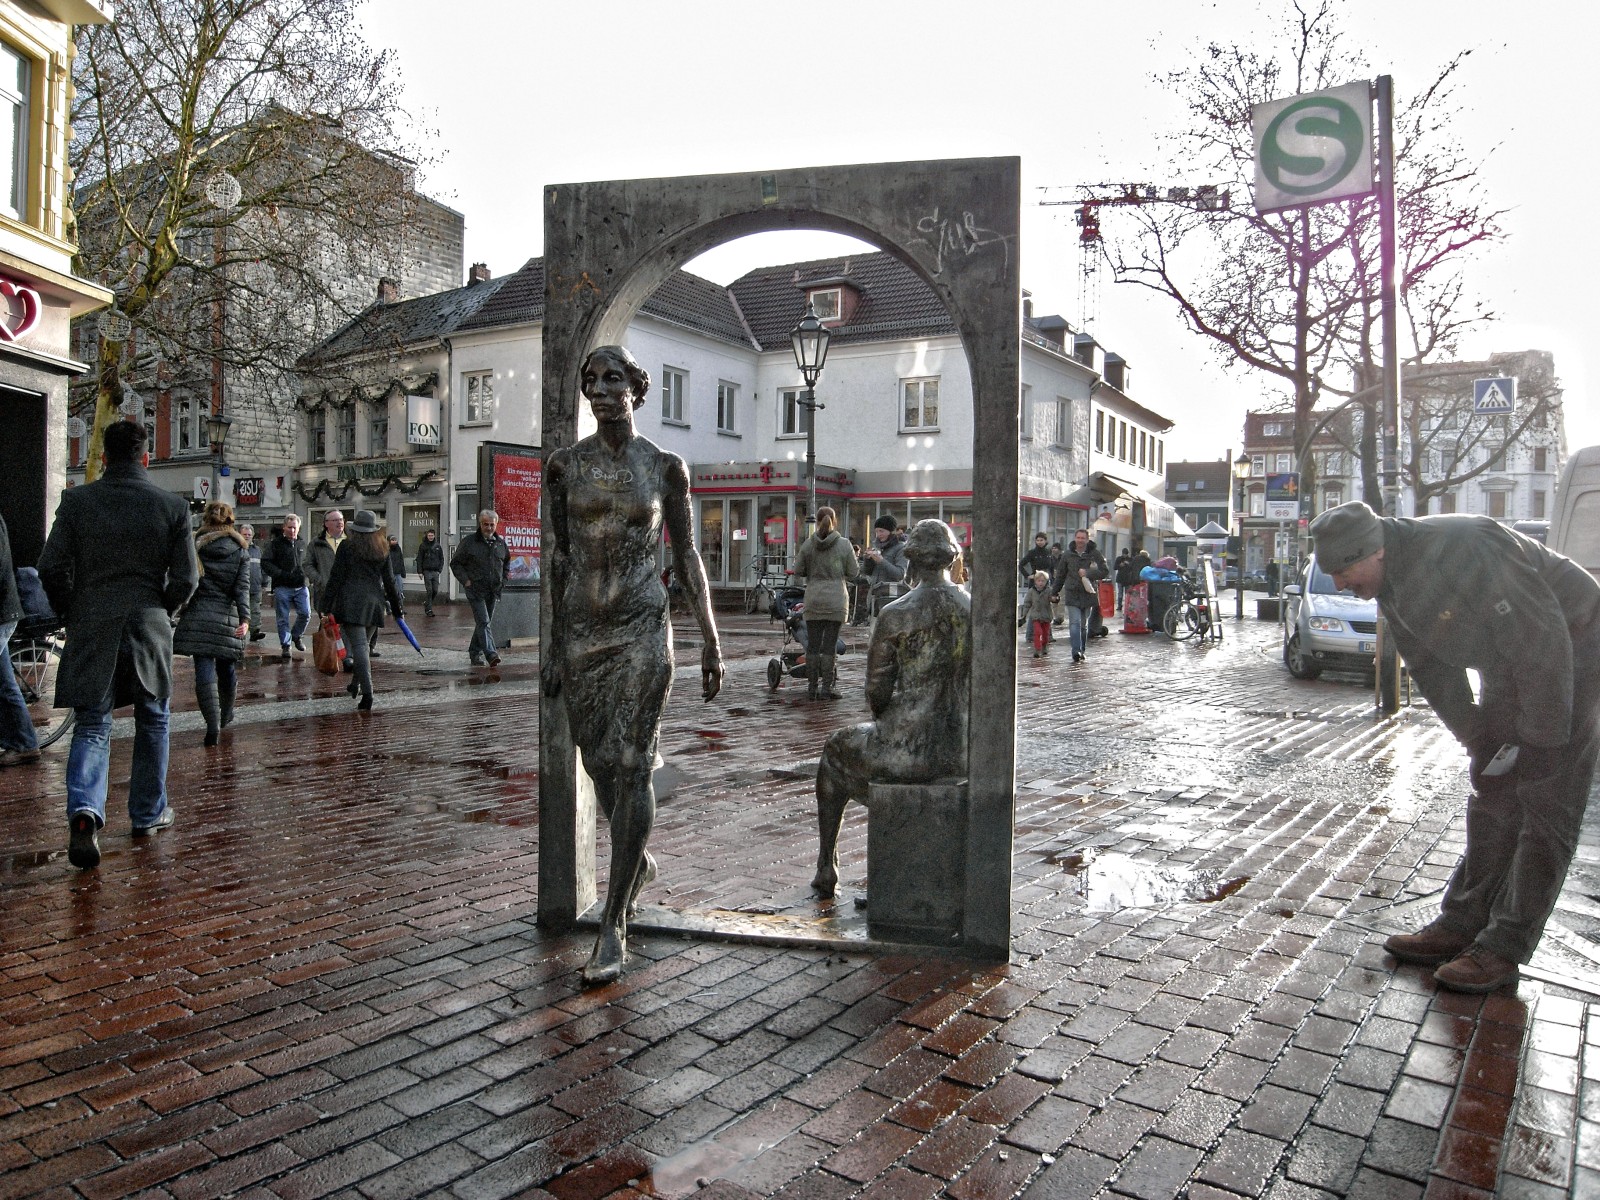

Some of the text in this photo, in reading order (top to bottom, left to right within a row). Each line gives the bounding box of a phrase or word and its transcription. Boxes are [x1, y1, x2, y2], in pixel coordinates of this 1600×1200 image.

[1275, 106, 1347, 188] S
[410, 422, 439, 438] FON
[409, 437, 440, 445] FRISEUR
[414, 511, 429, 519] FON
[409, 519, 434, 527] FRISEUR
